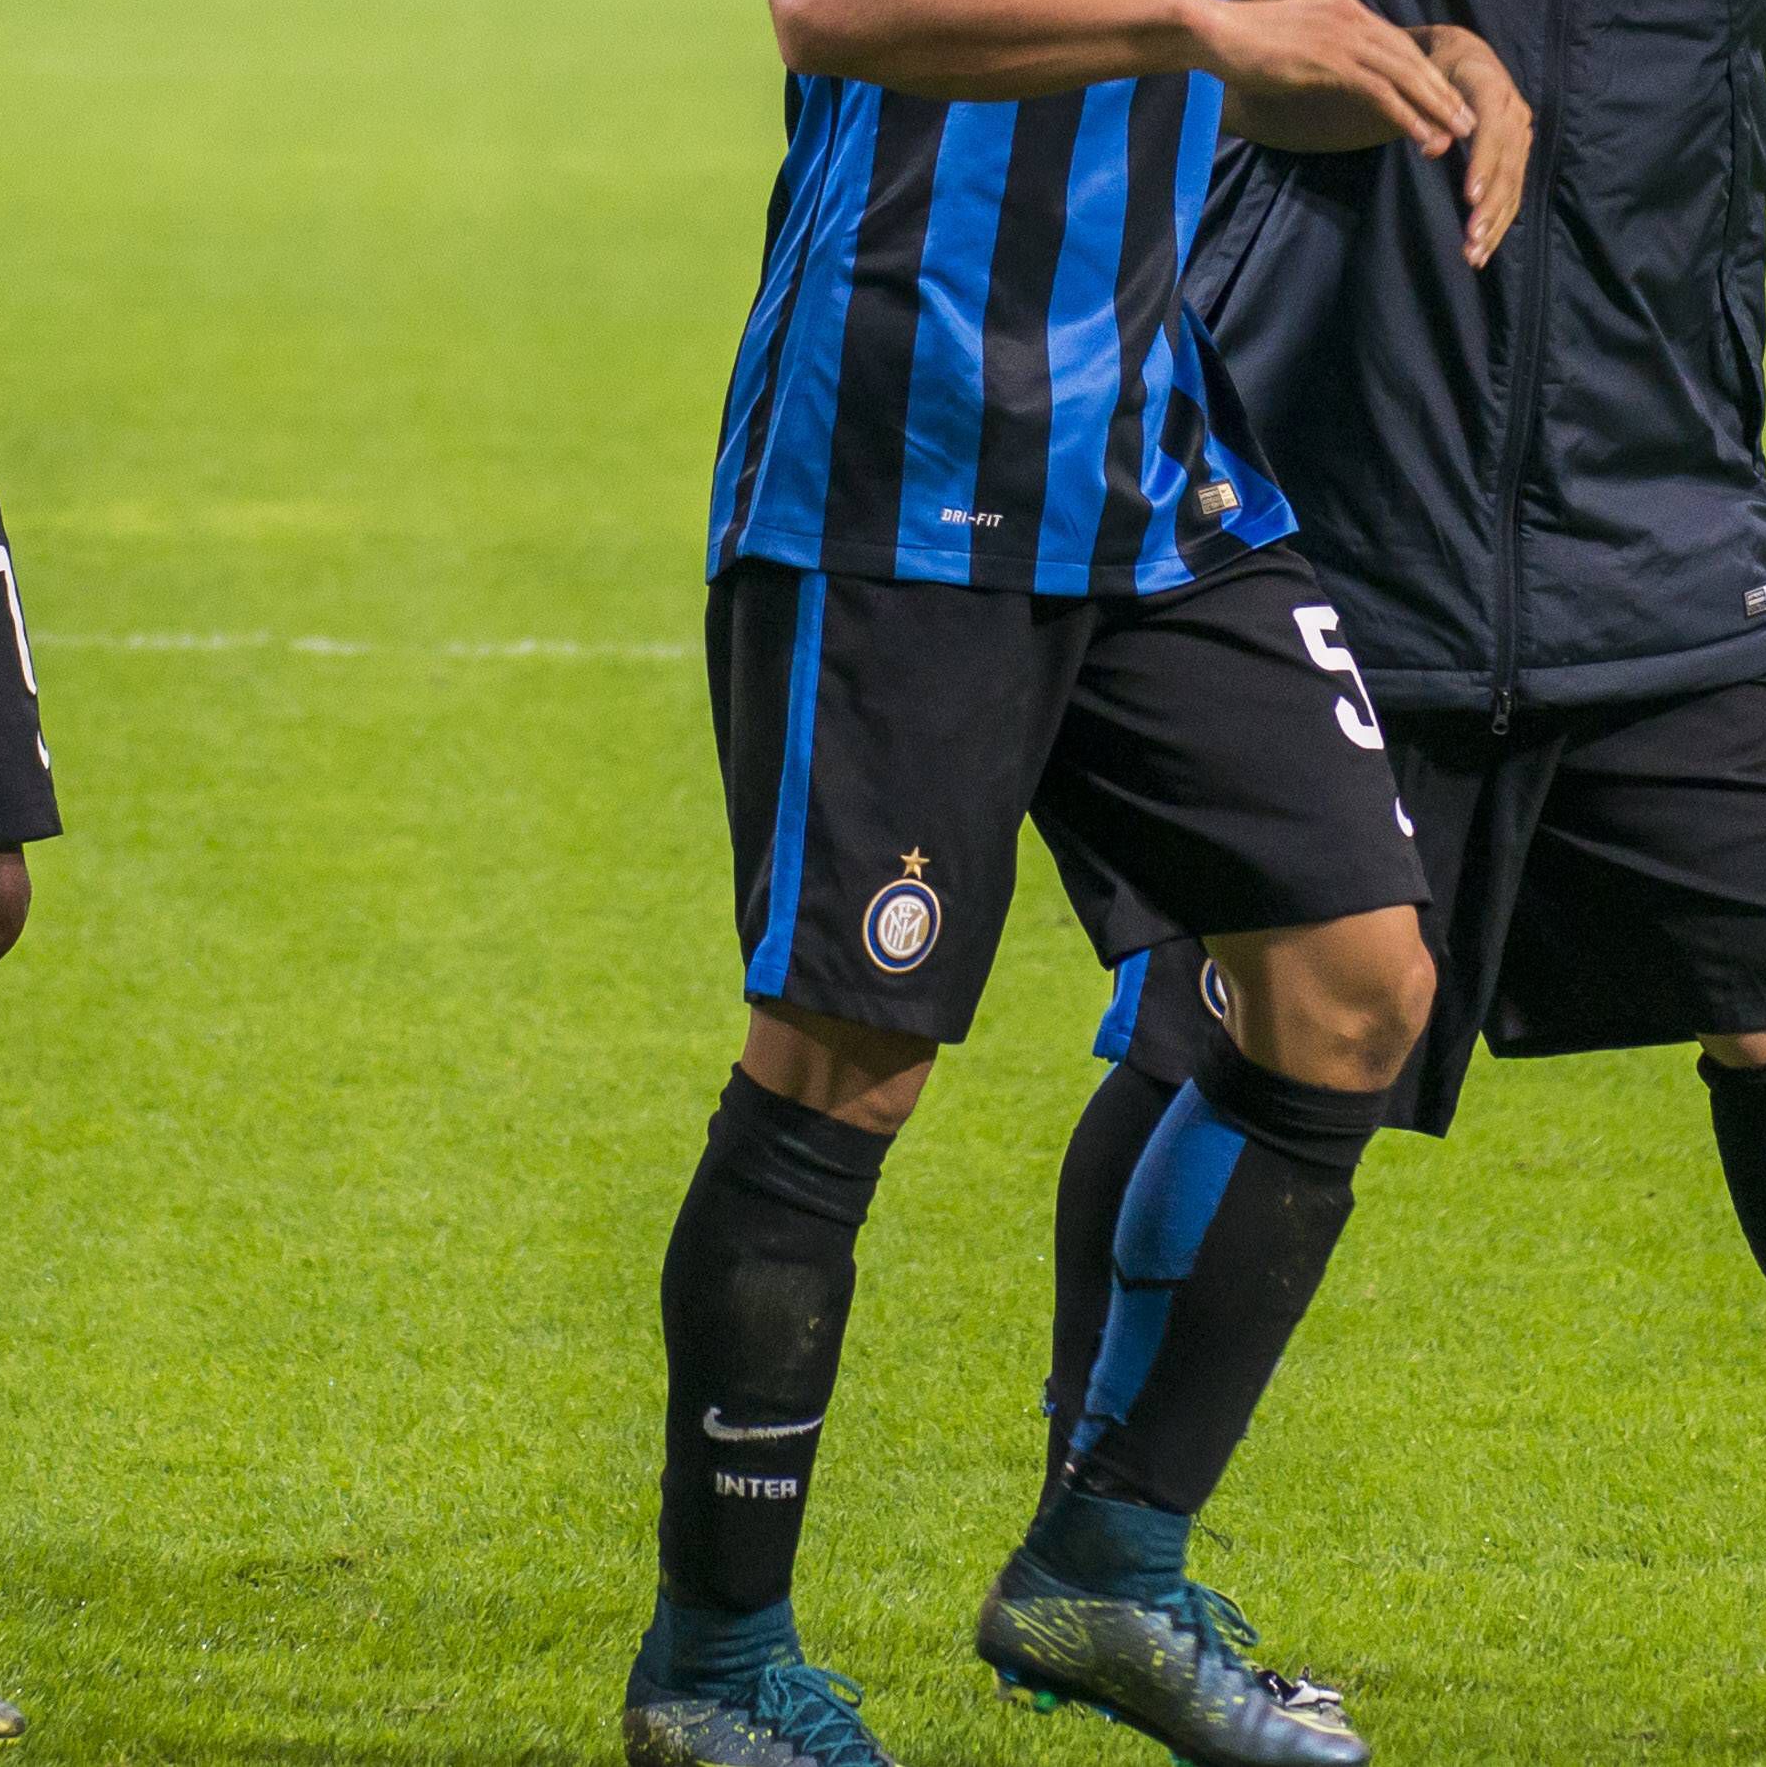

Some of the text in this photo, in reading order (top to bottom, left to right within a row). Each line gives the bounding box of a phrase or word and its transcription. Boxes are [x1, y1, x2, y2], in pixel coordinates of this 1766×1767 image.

[940, 507, 1004, 527] DRI-FIT
[1293, 605, 1385, 750] 5
[715, 1471, 798, 1500] INTER
